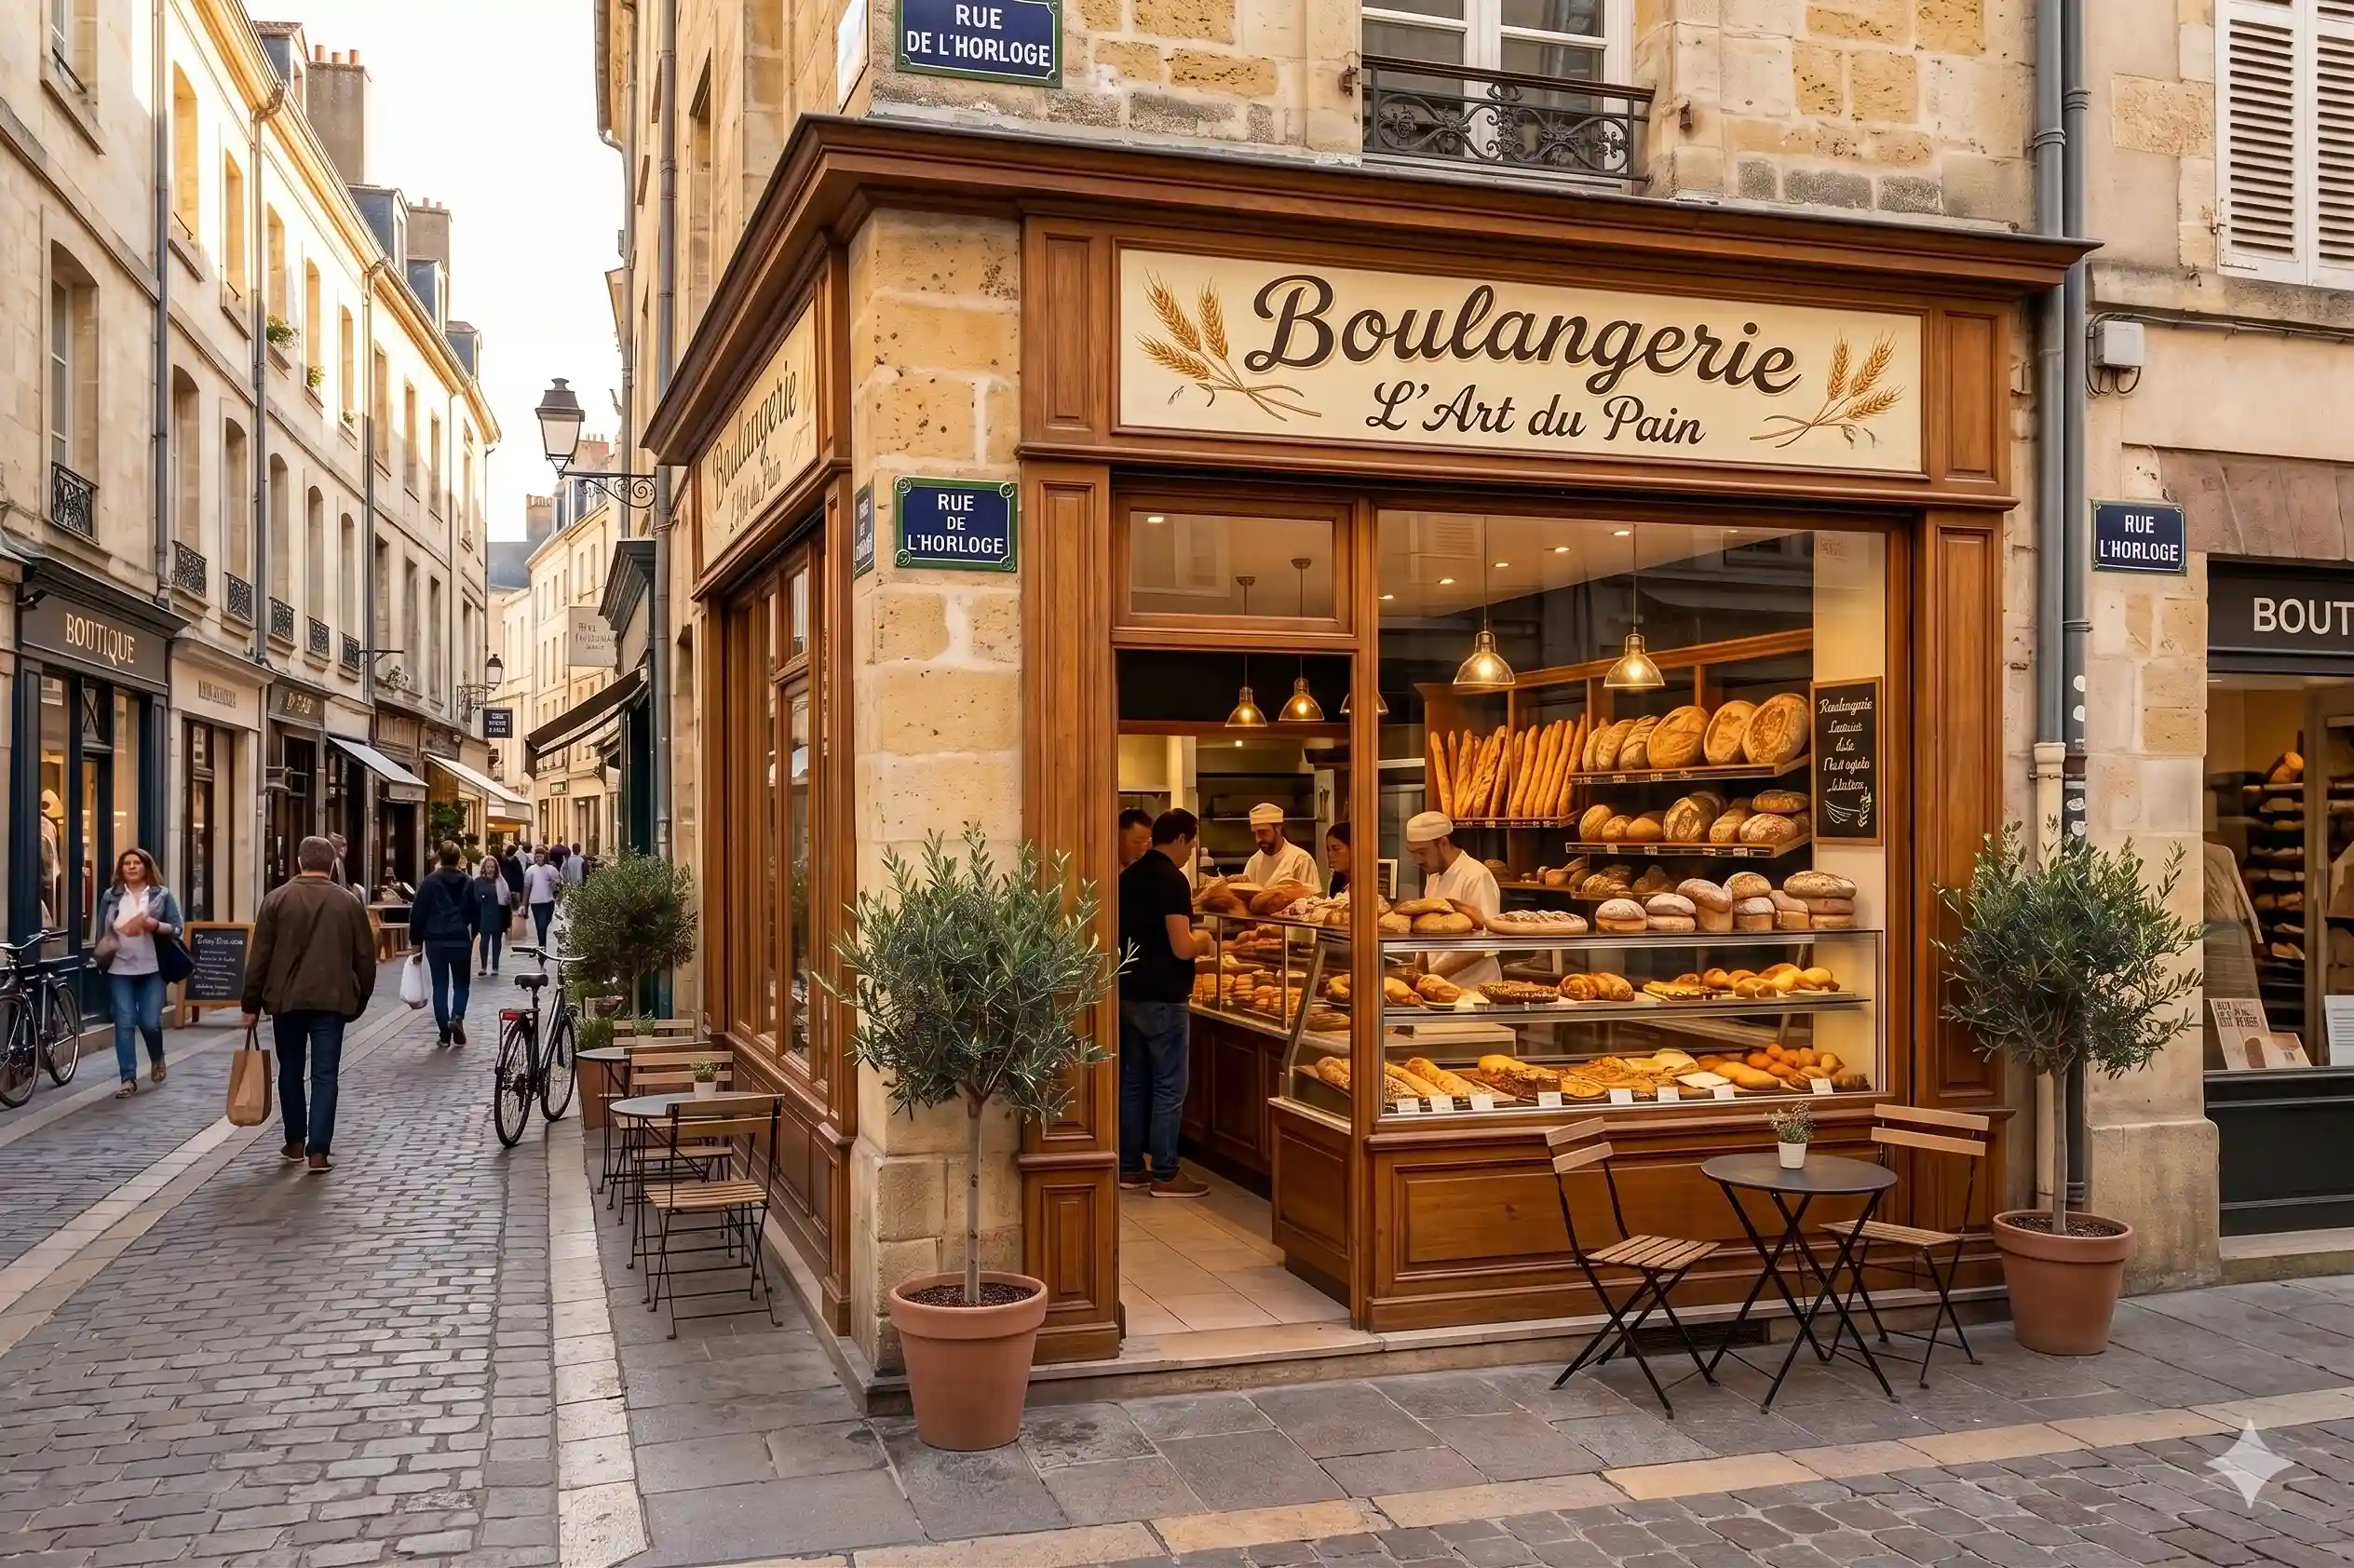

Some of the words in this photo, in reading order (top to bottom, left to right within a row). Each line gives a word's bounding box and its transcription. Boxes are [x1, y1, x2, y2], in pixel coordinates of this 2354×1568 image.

[955, 4, 1003, 30] RUE
[907, 30, 932, 53] DE
[939, 33, 1051, 67] L'HORLOGE
[1244, 274, 1801, 396] Boulangerie
[1365, 380, 1516, 434] L'Art
[1528, 393, 1587, 438] du
[1603, 395, 1706, 445] Pain
[712, 360, 797, 511] Boulangerie
[938, 493, 974, 511] RUE
[946, 516, 967, 531] DE
[2124, 514, 2155, 534] RUE
[907, 534, 1004, 555] L'HORLOGE
[2100, 539, 2179, 562] L'HORLOGE
[2253, 597, 2354, 636] BOUT
[65, 613, 135, 666] BOUTIQUE
